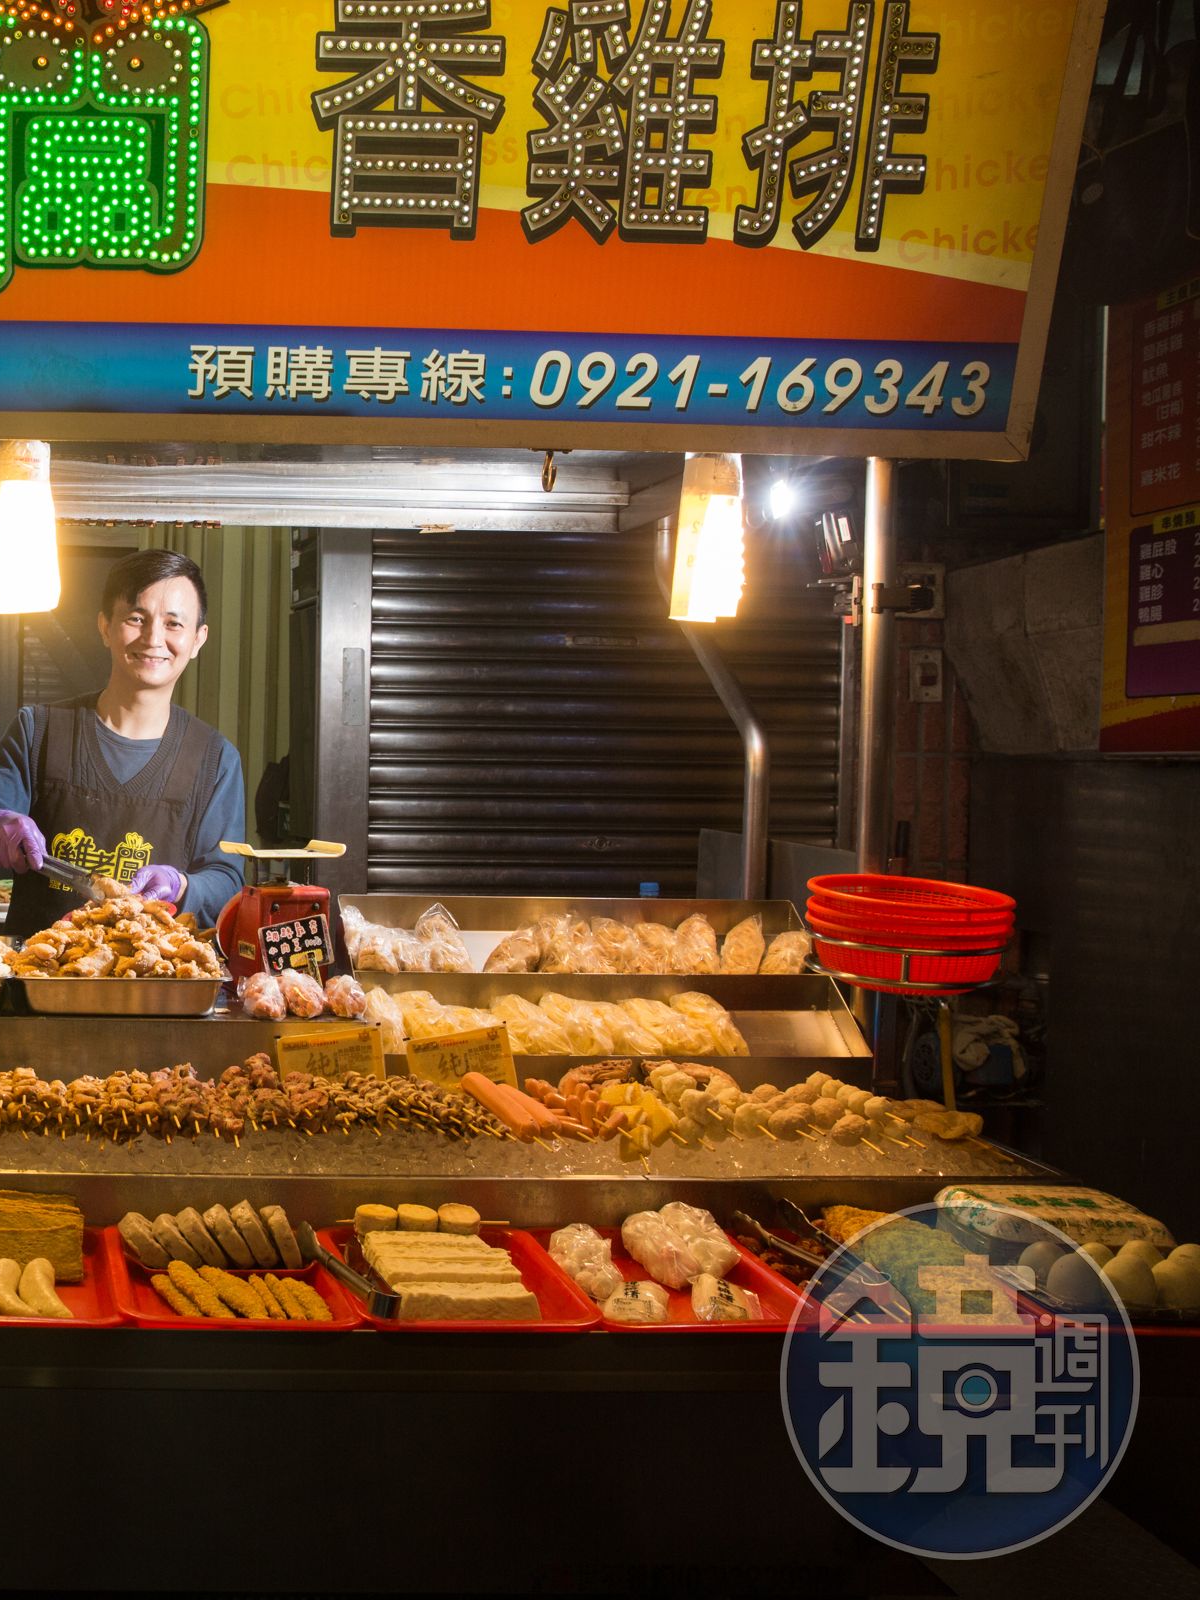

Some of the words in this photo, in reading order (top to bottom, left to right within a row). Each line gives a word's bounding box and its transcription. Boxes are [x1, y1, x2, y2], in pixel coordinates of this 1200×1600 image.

[311, 0, 938, 250] 香雞排
[897, 220, 1040, 264] Chicke
